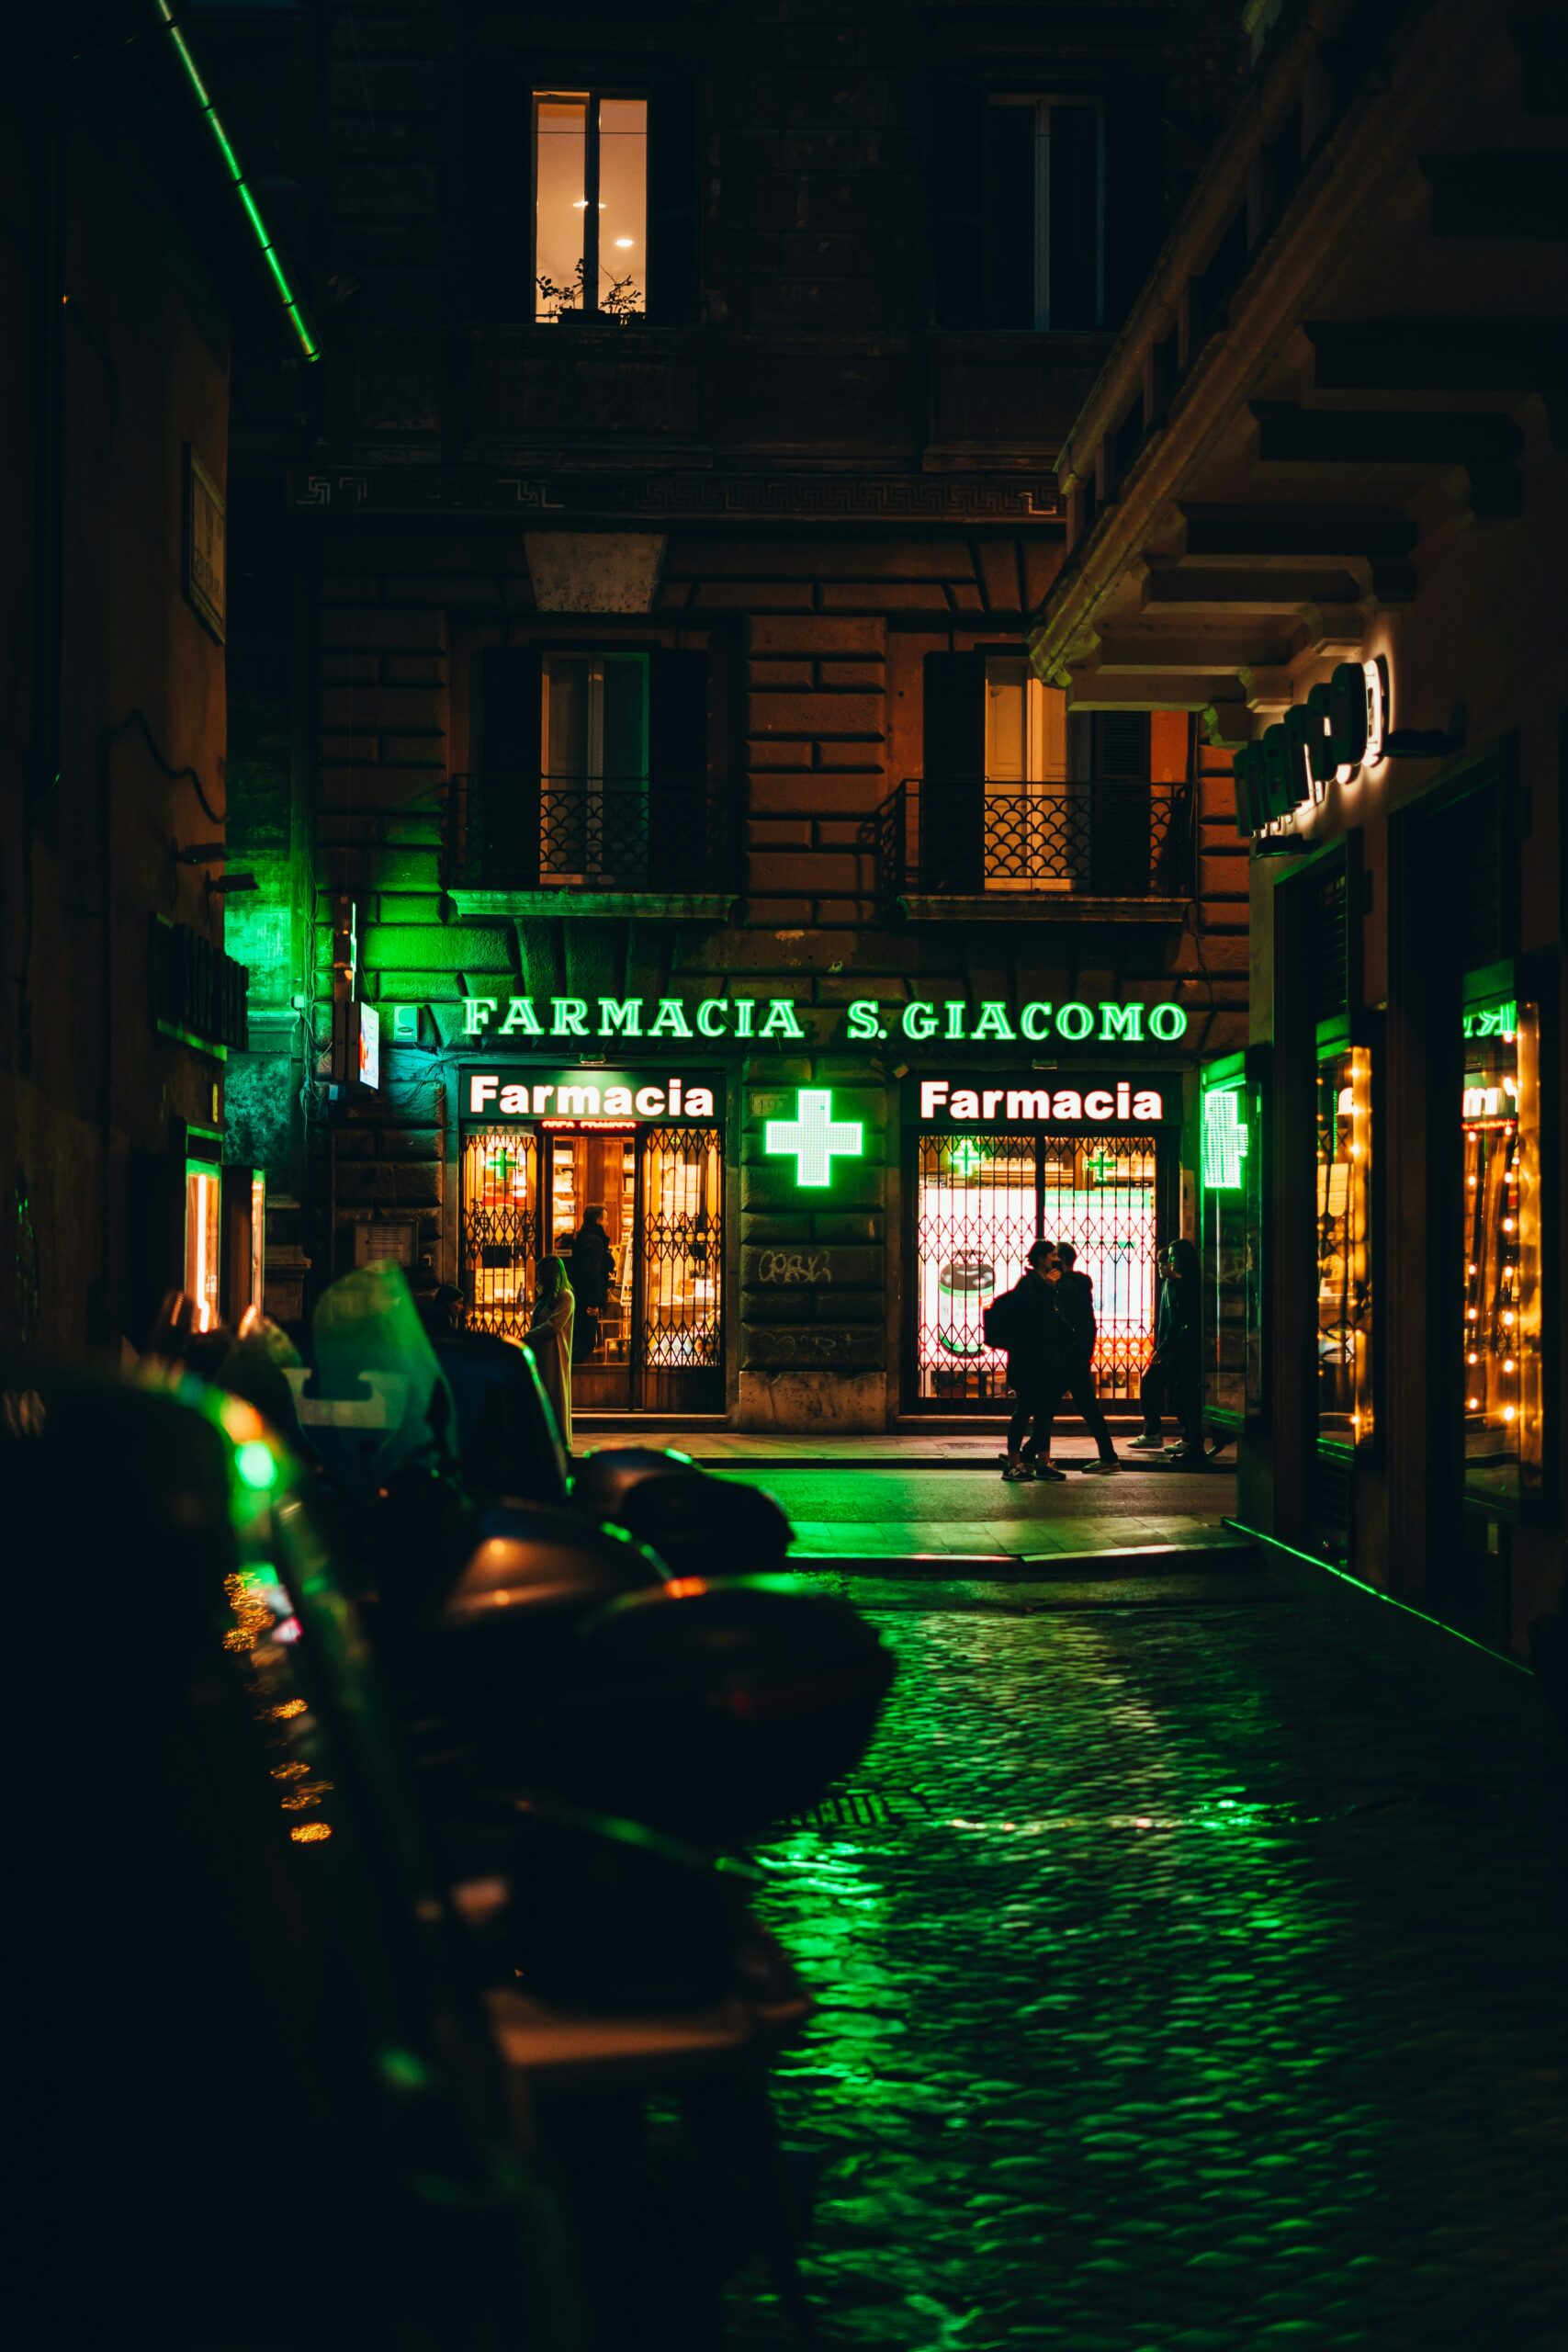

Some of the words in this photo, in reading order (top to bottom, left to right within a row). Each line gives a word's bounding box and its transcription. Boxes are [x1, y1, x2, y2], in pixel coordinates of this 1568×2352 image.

[462, 995, 806, 1038] FARMACIA
[470, 1070, 713, 1116] Farmacia
[921, 1081, 1162, 1120] Farmacia
